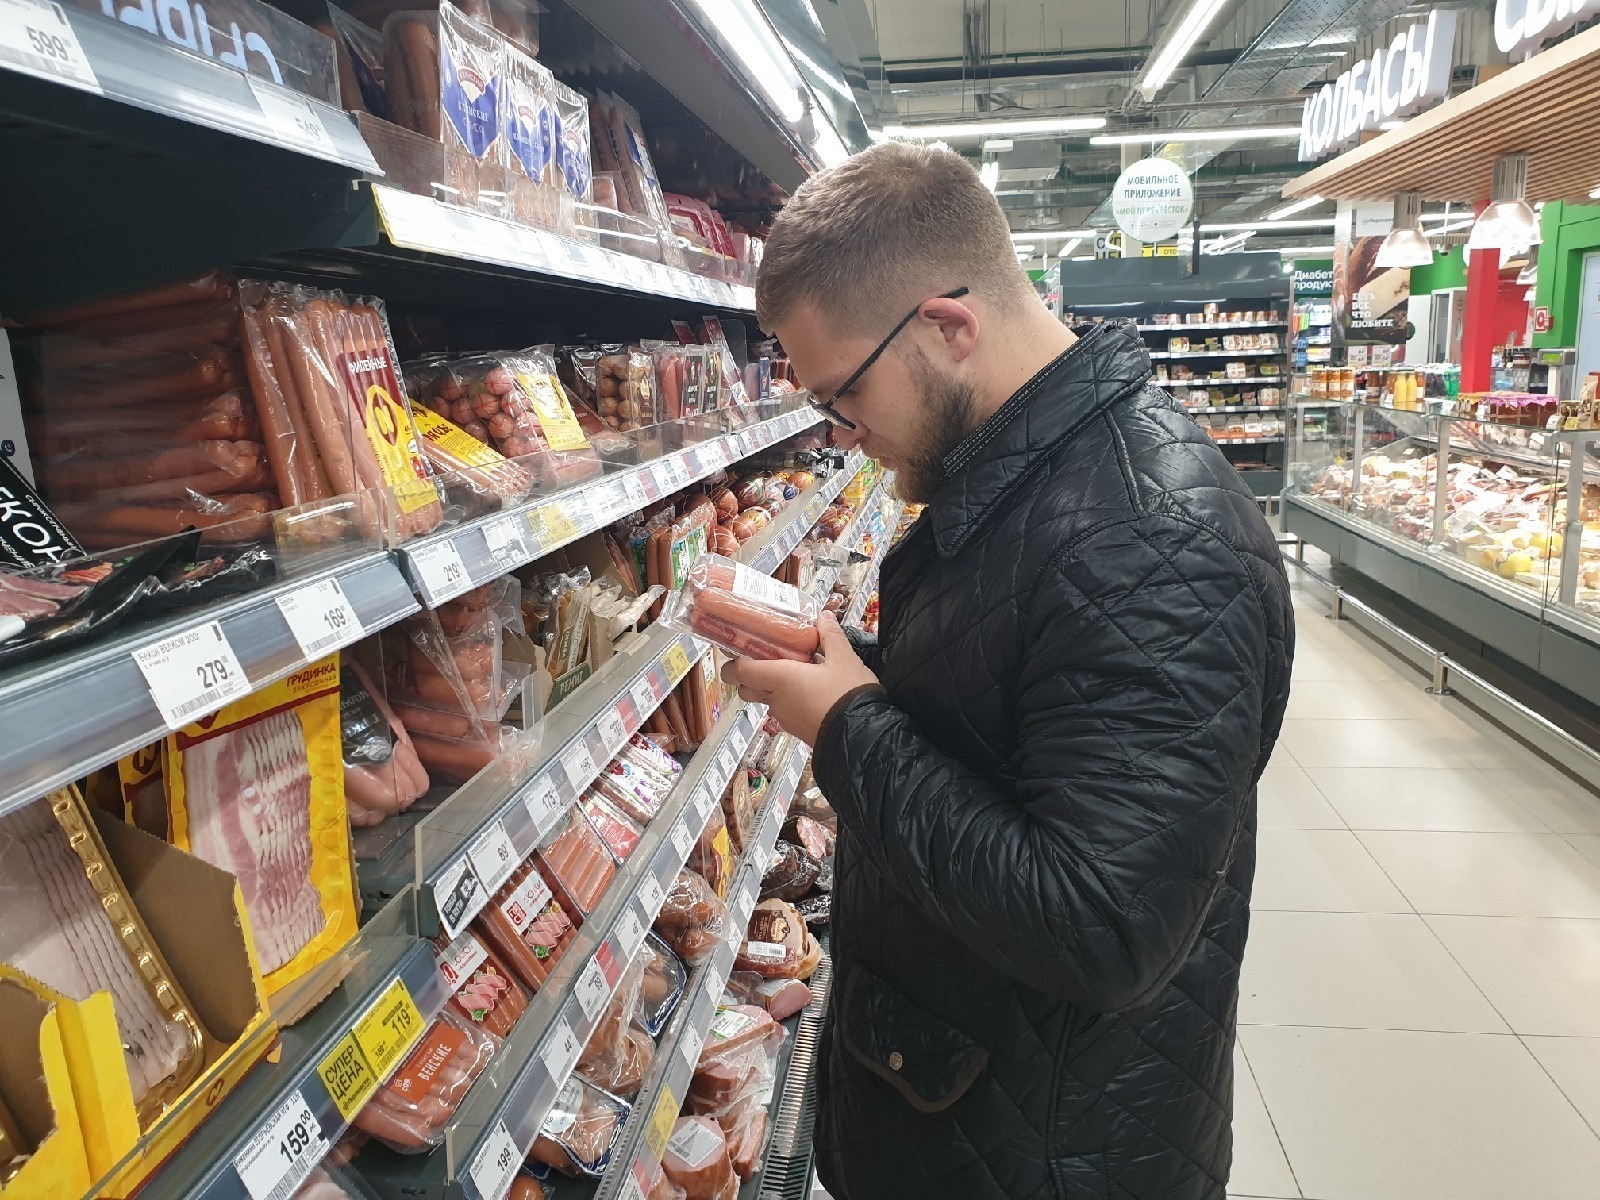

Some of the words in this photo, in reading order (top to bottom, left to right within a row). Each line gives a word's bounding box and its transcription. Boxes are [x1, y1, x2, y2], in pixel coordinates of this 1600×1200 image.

[1494, 0, 1586, 52] СЫ
[26, 27, 69, 62] 599
[1298, 9, 1456, 161] КОЛБАСЫ
[1127, 174, 1179, 185] МОБИЛЬНОЕ
[1124, 188, 1181, 198] ПРИЛОЖЕНИЕ
[1294, 270, 1334, 281] Диабет
[1352, 292, 1376, 300] ЕСТЬ
[1351, 319, 1394, 328] ЛЮБИТЕ
[1352, 311, 1371, 319] ЧТО
[347, 356, 389, 375] ФИЛЕЙНЫЕ
[0, 486, 63, 565] ЕКОН
[444, 564, 460, 585] 219
[323, 608, 346, 629] 169
[197, 660, 228, 689] 279
[286, 663, 337, 688] ГРУДИНКА
[292, 675, 338, 695] ЗАКУСОЧНАЯ
[559, 672, 584, 695] РЕМИТ
[391, 1011, 412, 1035] 119
[324, 1046, 355, 1085] СУПЕР
[420, 1042, 452, 1082] ВЕНСКИЕ
[331, 1064, 364, 1101] ЦЕНА
[279, 1120, 310, 1163] 159
[497, 1147, 511, 1172] 199
